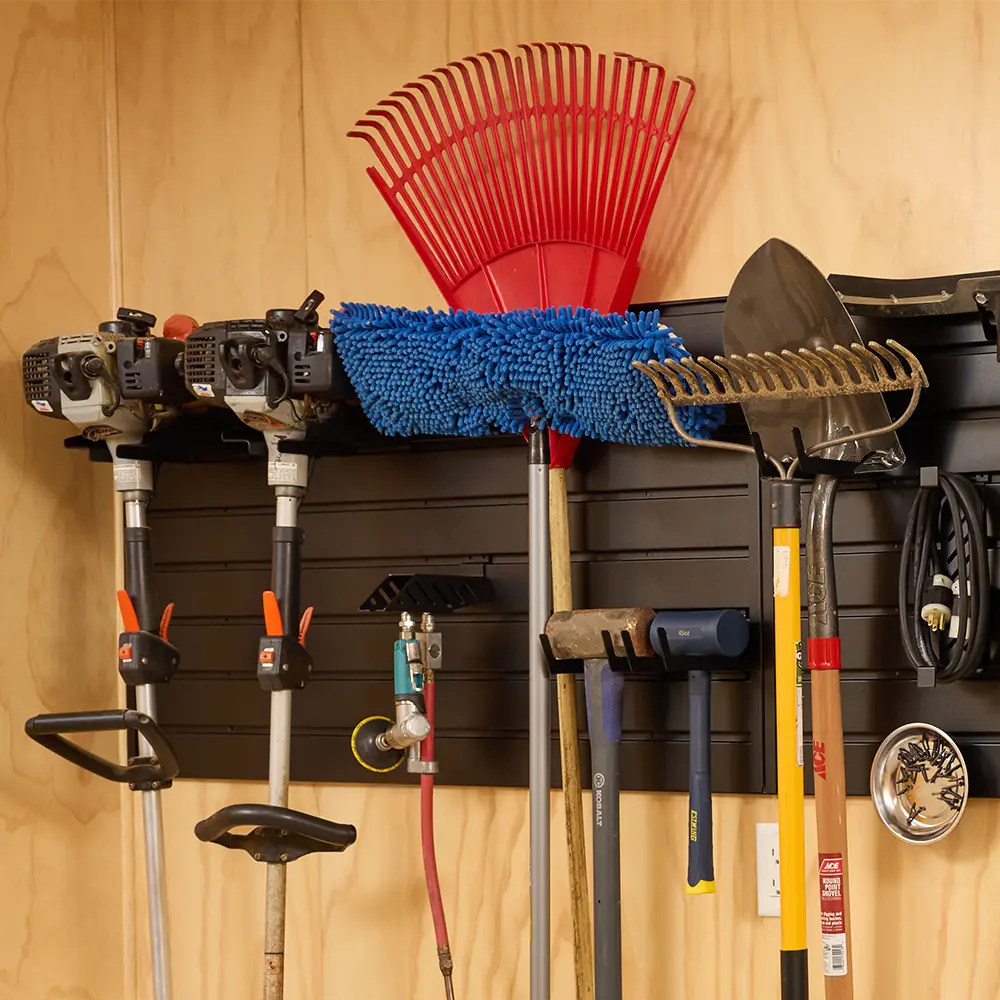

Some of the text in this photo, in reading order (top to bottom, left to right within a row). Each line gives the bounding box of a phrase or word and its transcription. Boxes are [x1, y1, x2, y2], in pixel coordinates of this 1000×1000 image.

[807, 565, 828, 625] ACE
[813, 740, 826, 780] ACE
[595, 789, 603, 827] KOBALT
[824, 862, 840, 870] ACE
